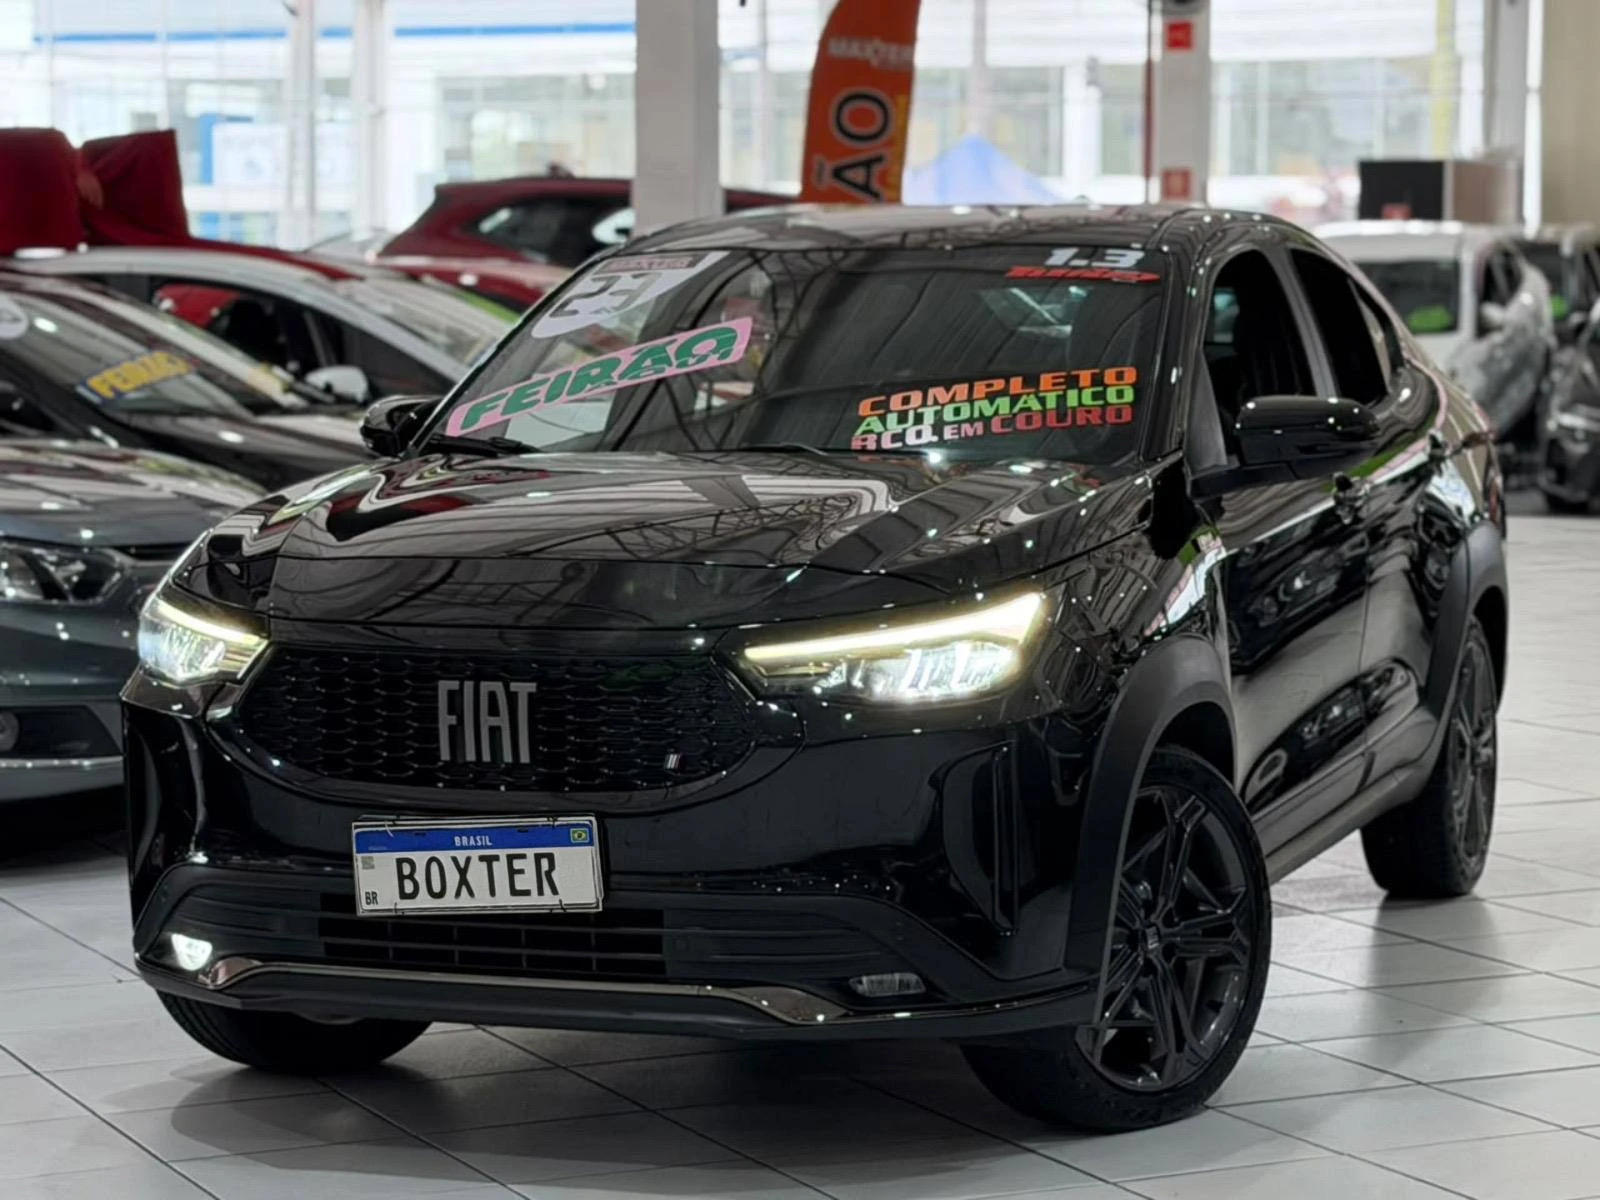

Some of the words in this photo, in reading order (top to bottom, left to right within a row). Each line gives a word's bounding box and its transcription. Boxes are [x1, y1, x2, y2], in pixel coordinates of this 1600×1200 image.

[1044, 247, 1146, 268] 1.3
[460, 326, 739, 431] FEIRÃO
[858, 366, 1137, 417] COMPLETO
[943, 421, 985, 440] EM
[991, 404, 1133, 434] COURO
[438, 680, 537, 763] FIAT
[454, 835, 493, 847] BRASIL
[395, 852, 559, 900] BOXTER
[364, 891, 379, 906] BR
